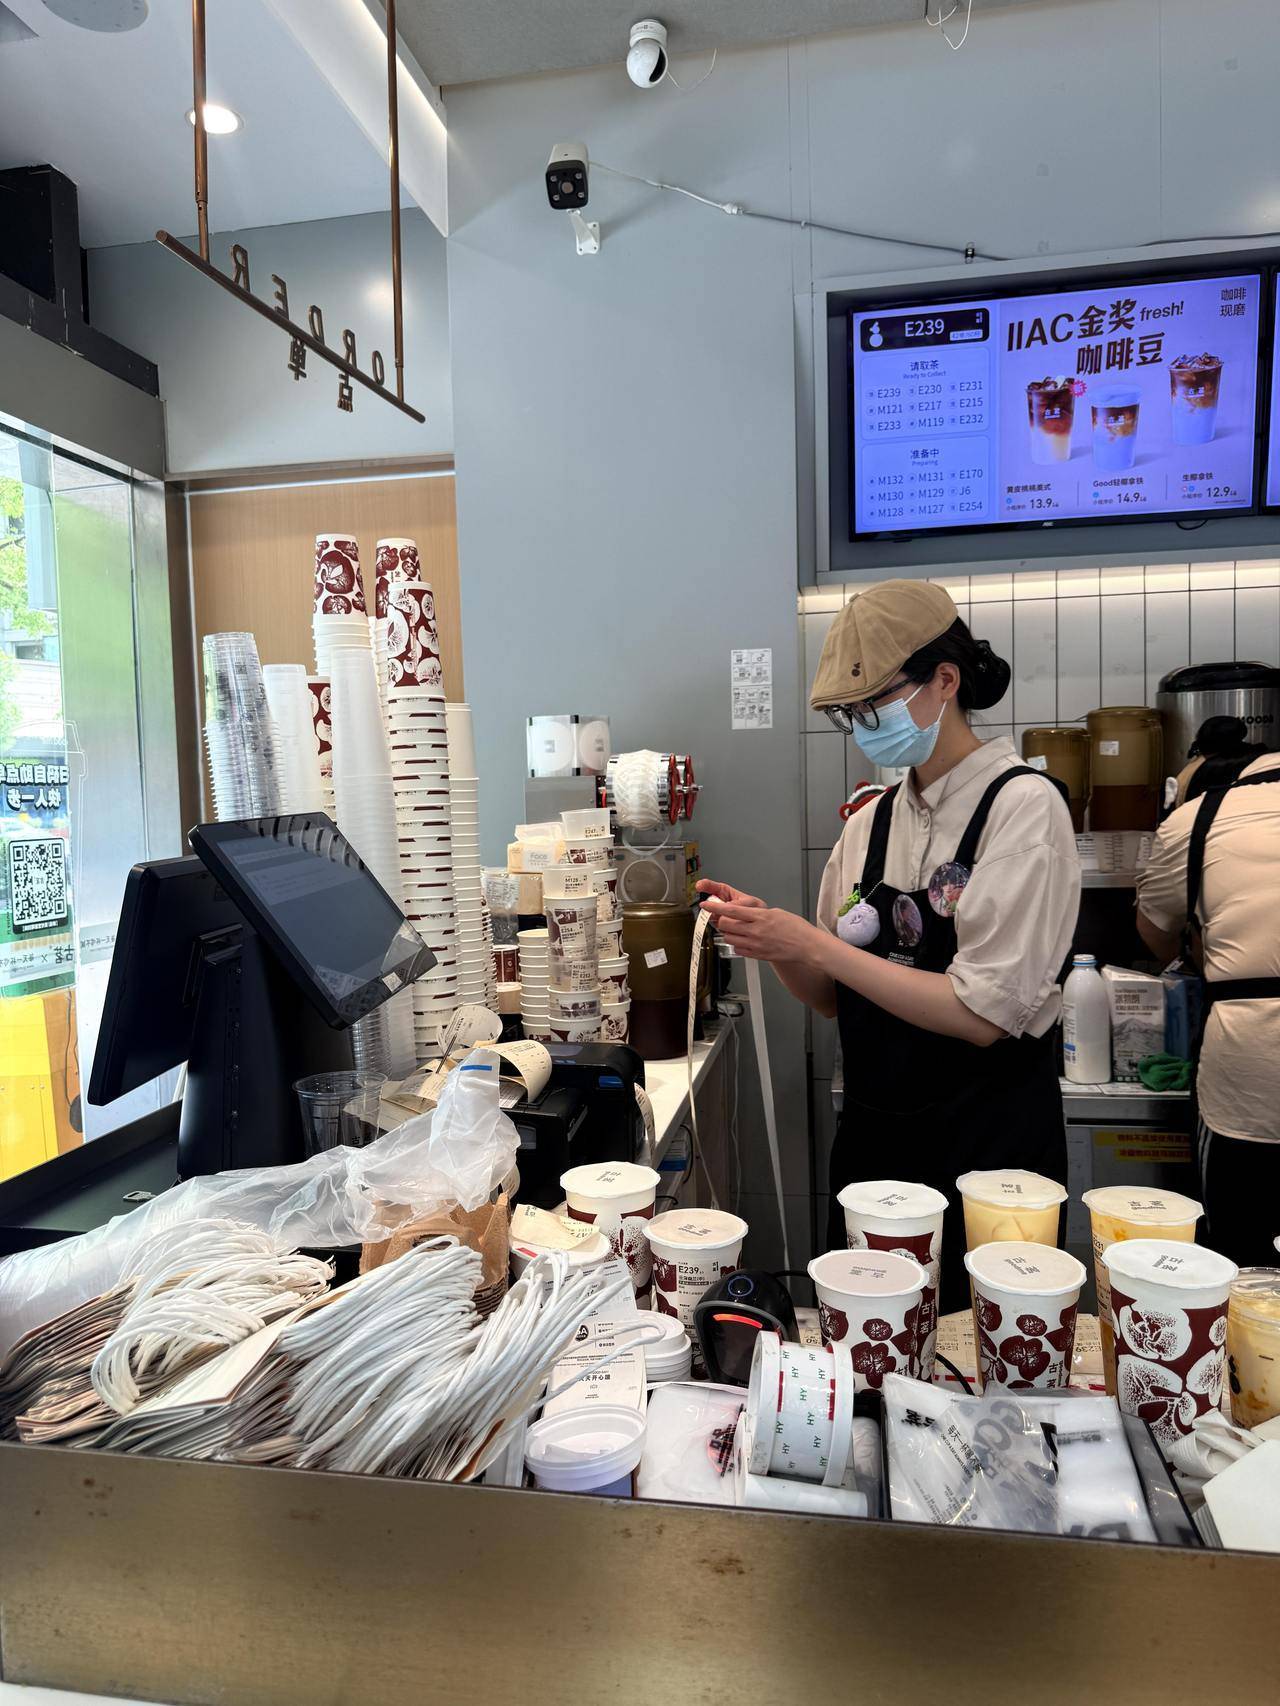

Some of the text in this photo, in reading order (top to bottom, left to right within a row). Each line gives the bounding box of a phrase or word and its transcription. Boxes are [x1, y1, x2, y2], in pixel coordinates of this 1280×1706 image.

[1140, 301, 1184, 322] fresh!
[904, 319, 945, 338] E239
[1076, 331, 1165, 375] 咖啡豆
[877, 380, 983, 399] E239 E230 E231
[877, 397, 983, 415] M121 E217 E215
[877, 413, 983, 432] E233 M119 E232
[910, 448, 940, 460] 准备中
[877, 468, 983, 486] M132 M131 E170
[877, 485, 972, 502] M130 M129 J6
[877, 501, 983, 519] M128 M127 E254
[679, 1266, 699, 1274] E239
[783, 1351, 790, 1359] HY
[792, 1366, 799, 1378] HY
[818, 1368, 826, 1379] HY
[800, 1388, 807, 1401] HY
[807, 1412, 815, 1425] HY
[776, 1421, 784, 1434] HY
[782, 1443, 790, 1454] HY
[813, 1436, 821, 1448] HY
[820, 1456, 828, 1467] HY
